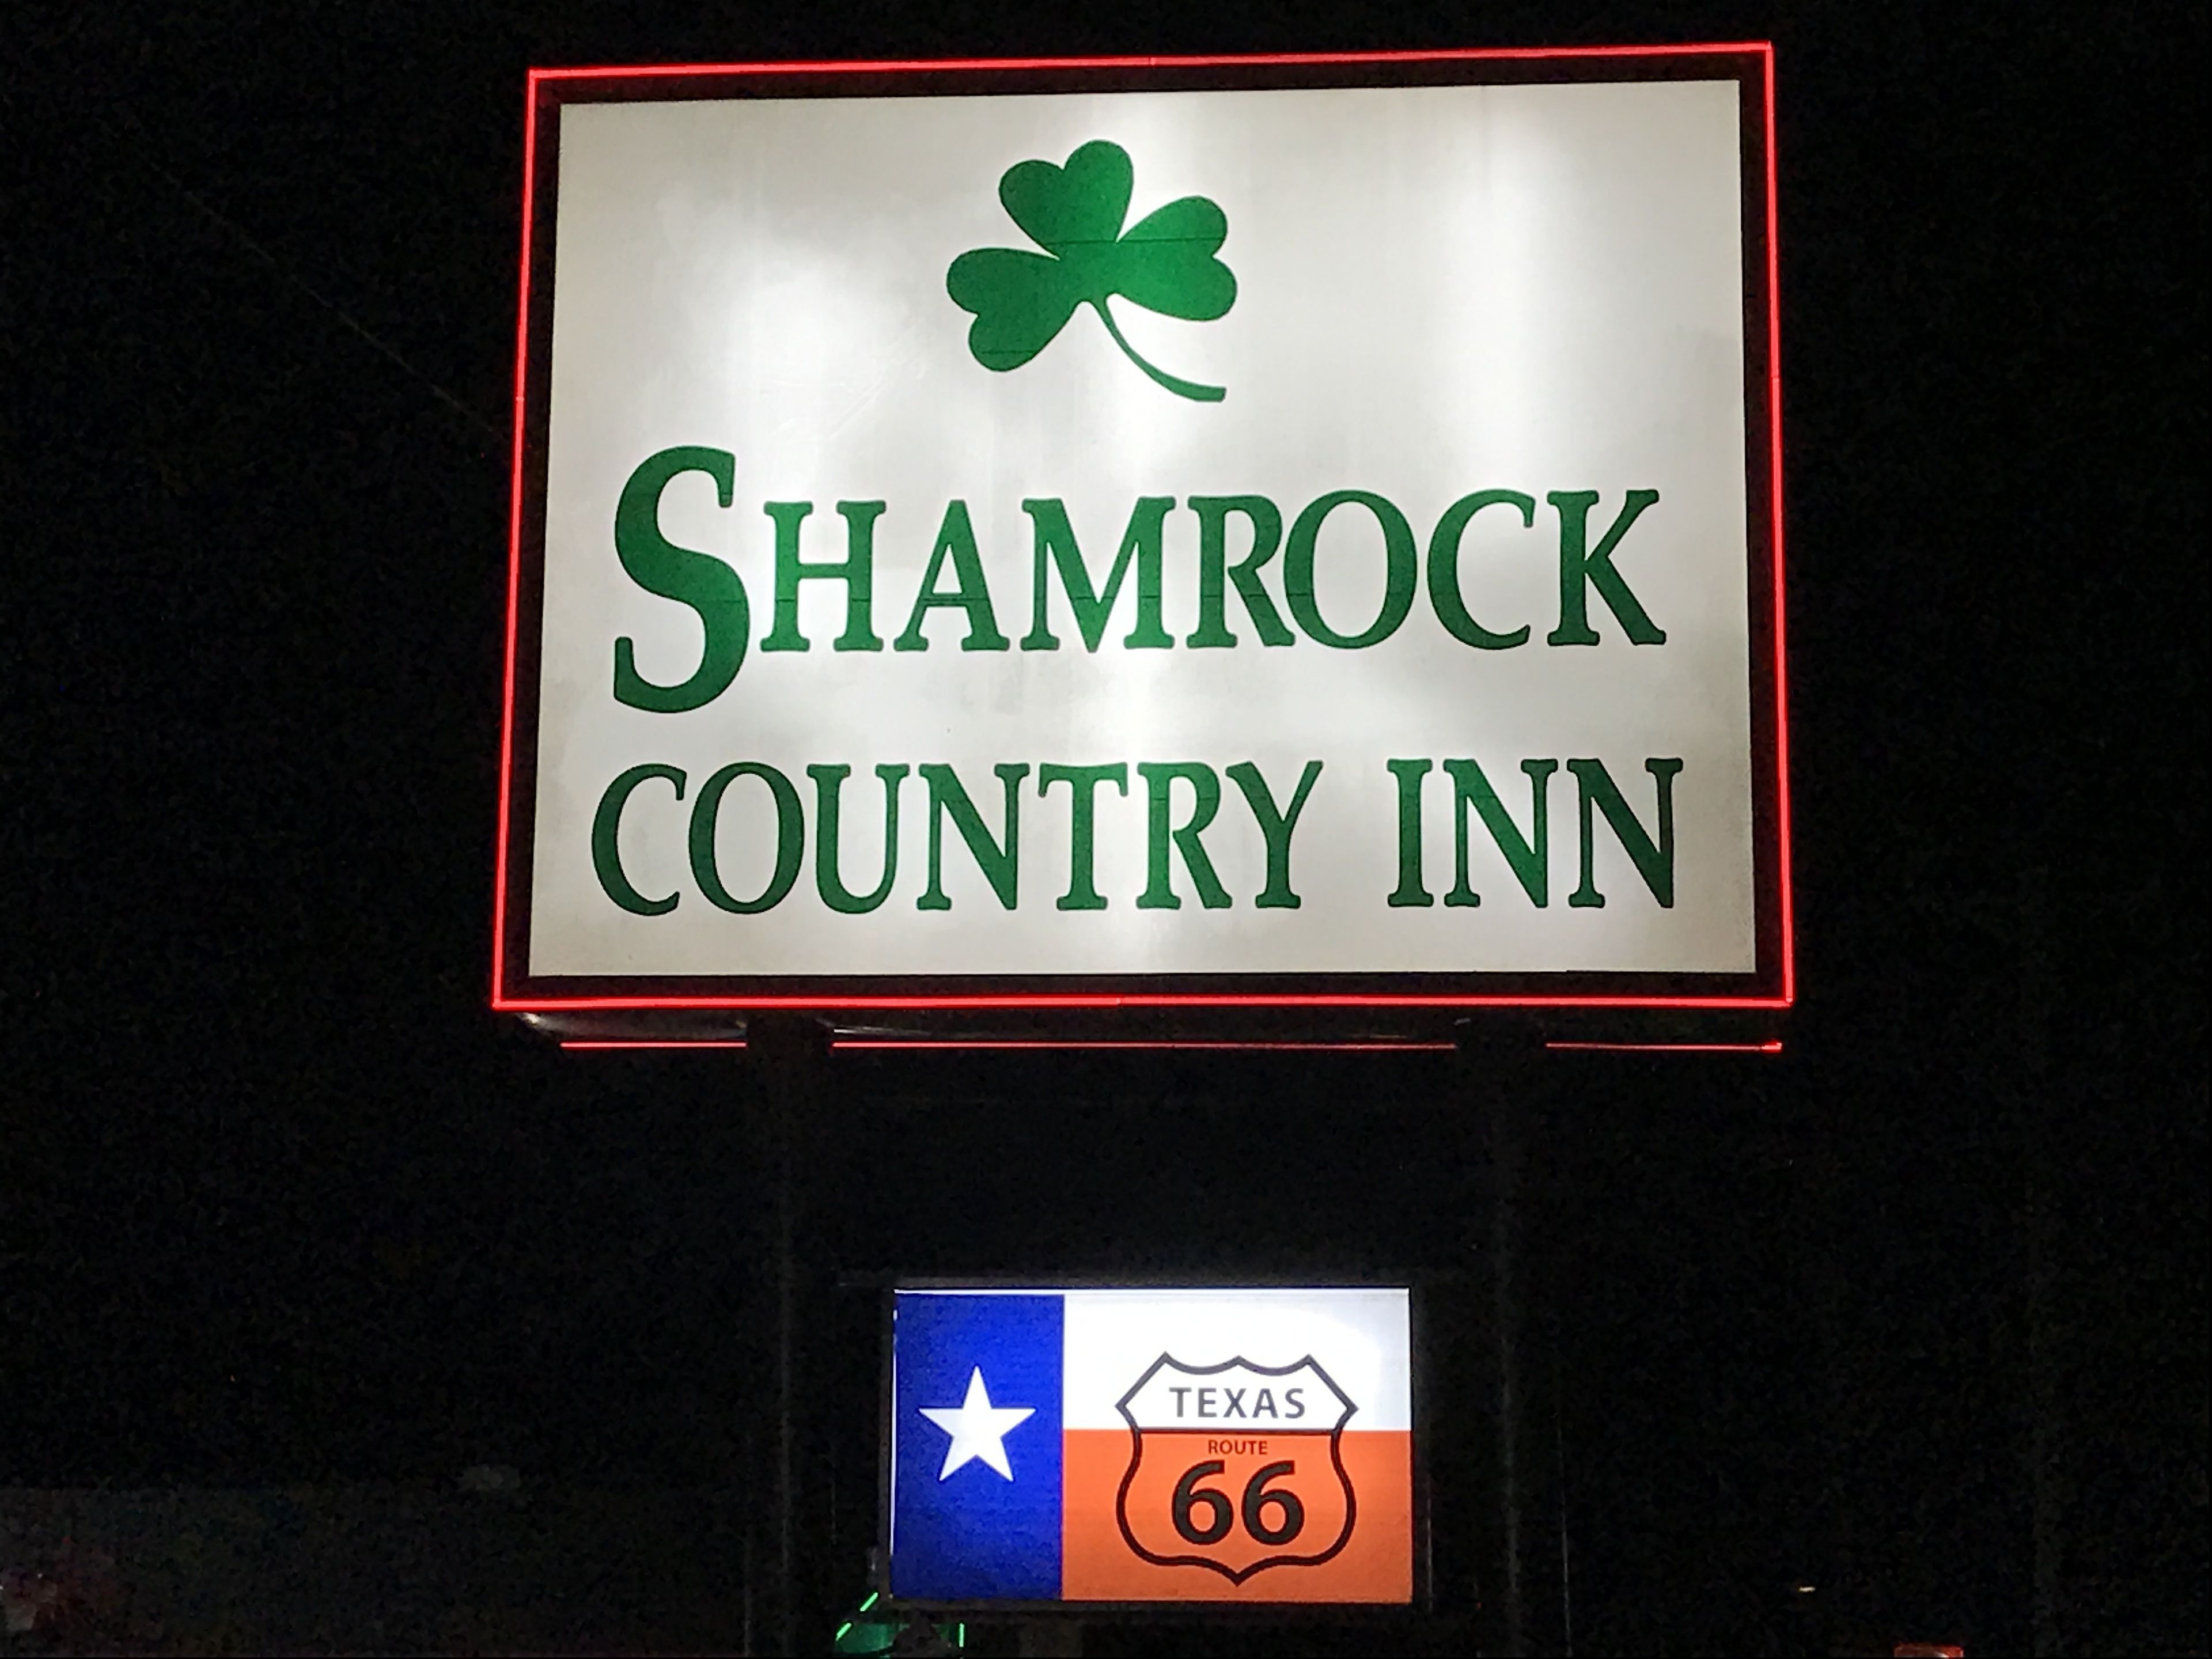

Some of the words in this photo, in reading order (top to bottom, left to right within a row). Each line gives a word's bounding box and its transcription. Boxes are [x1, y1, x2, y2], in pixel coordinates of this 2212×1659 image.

[614, 446, 1666, 713] SHAMROCK
[592, 762, 1322, 916] COUNTRY
[1388, 757, 1683, 908] INN
[1169, 1387, 1305, 1419] TEXAS
[1208, 1440, 1268, 1455] ROUTE
[1171, 1460, 1305, 1546] 66
